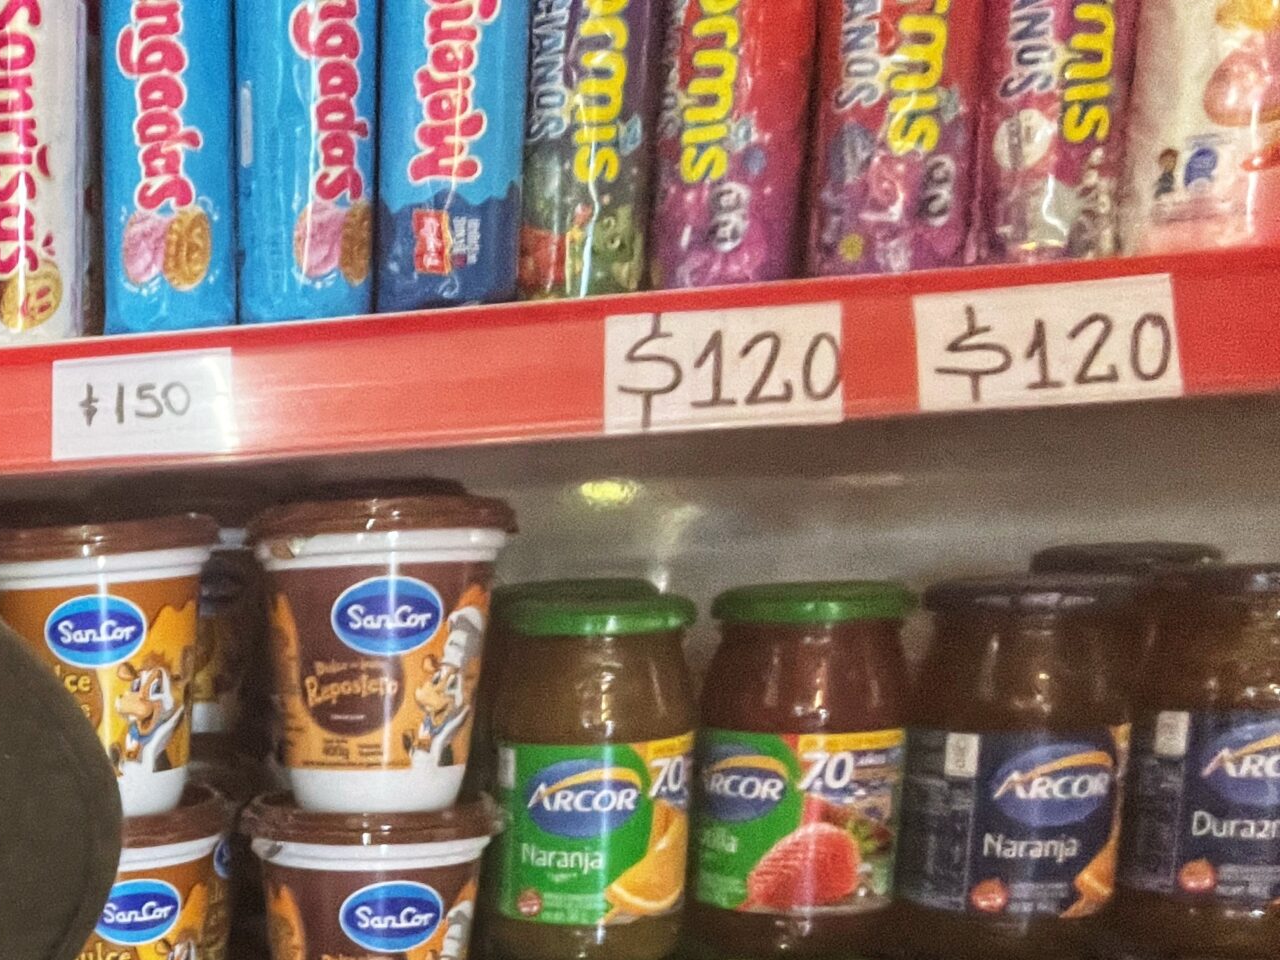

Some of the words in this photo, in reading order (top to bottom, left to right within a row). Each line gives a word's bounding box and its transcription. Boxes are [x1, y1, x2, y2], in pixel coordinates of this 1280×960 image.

[934, 305, 1171, 403] $120
[617, 312, 842, 429] $120
[79, 381, 191, 427] $150
[57, 619, 136, 644] SanCor
[346, 604, 432, 630] SanCor
[527, 782, 641, 813] ARCOR
[706, 773, 785, 801] RCOR
[993, 770, 1111, 800] ARCOR
[521, 842, 605, 875] Naranja
[982, 832, 1079, 863] Naranja
[104, 901, 176, 925] SanCor
[355, 906, 435, 930] SanCor
